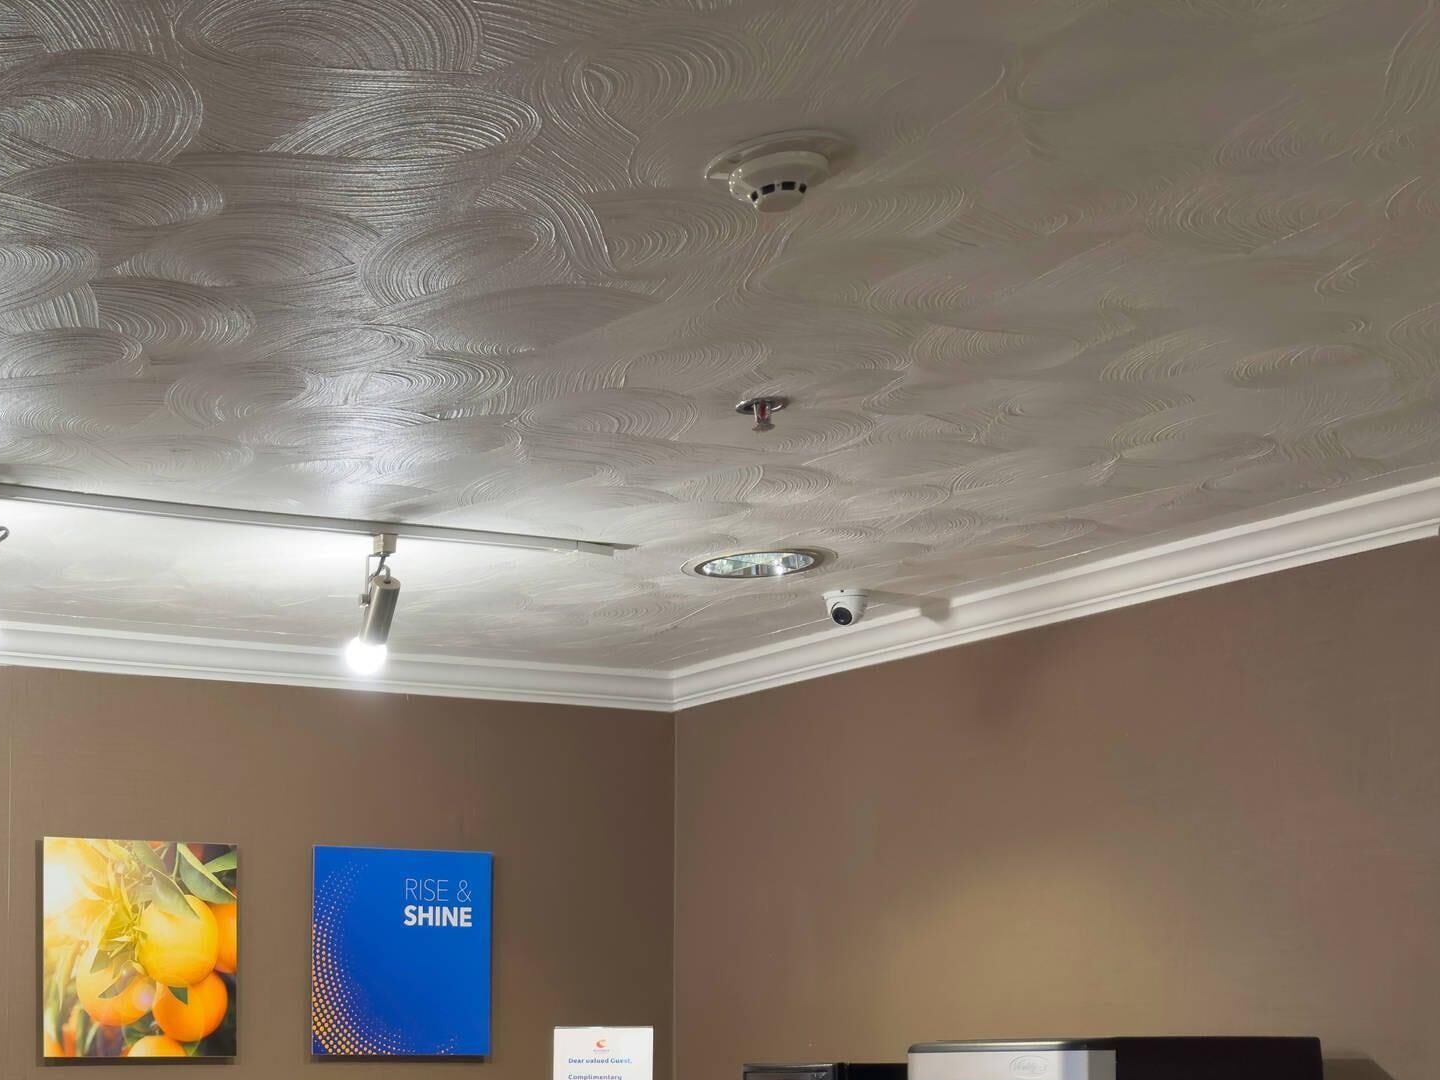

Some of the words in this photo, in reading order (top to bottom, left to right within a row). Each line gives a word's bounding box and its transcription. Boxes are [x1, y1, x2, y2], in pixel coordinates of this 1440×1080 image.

[405, 878, 449, 902] RISE
[456, 879, 472, 903] &
[403, 904, 473, 927] SHINE
[568, 1073, 622, 1080] Complimentary
